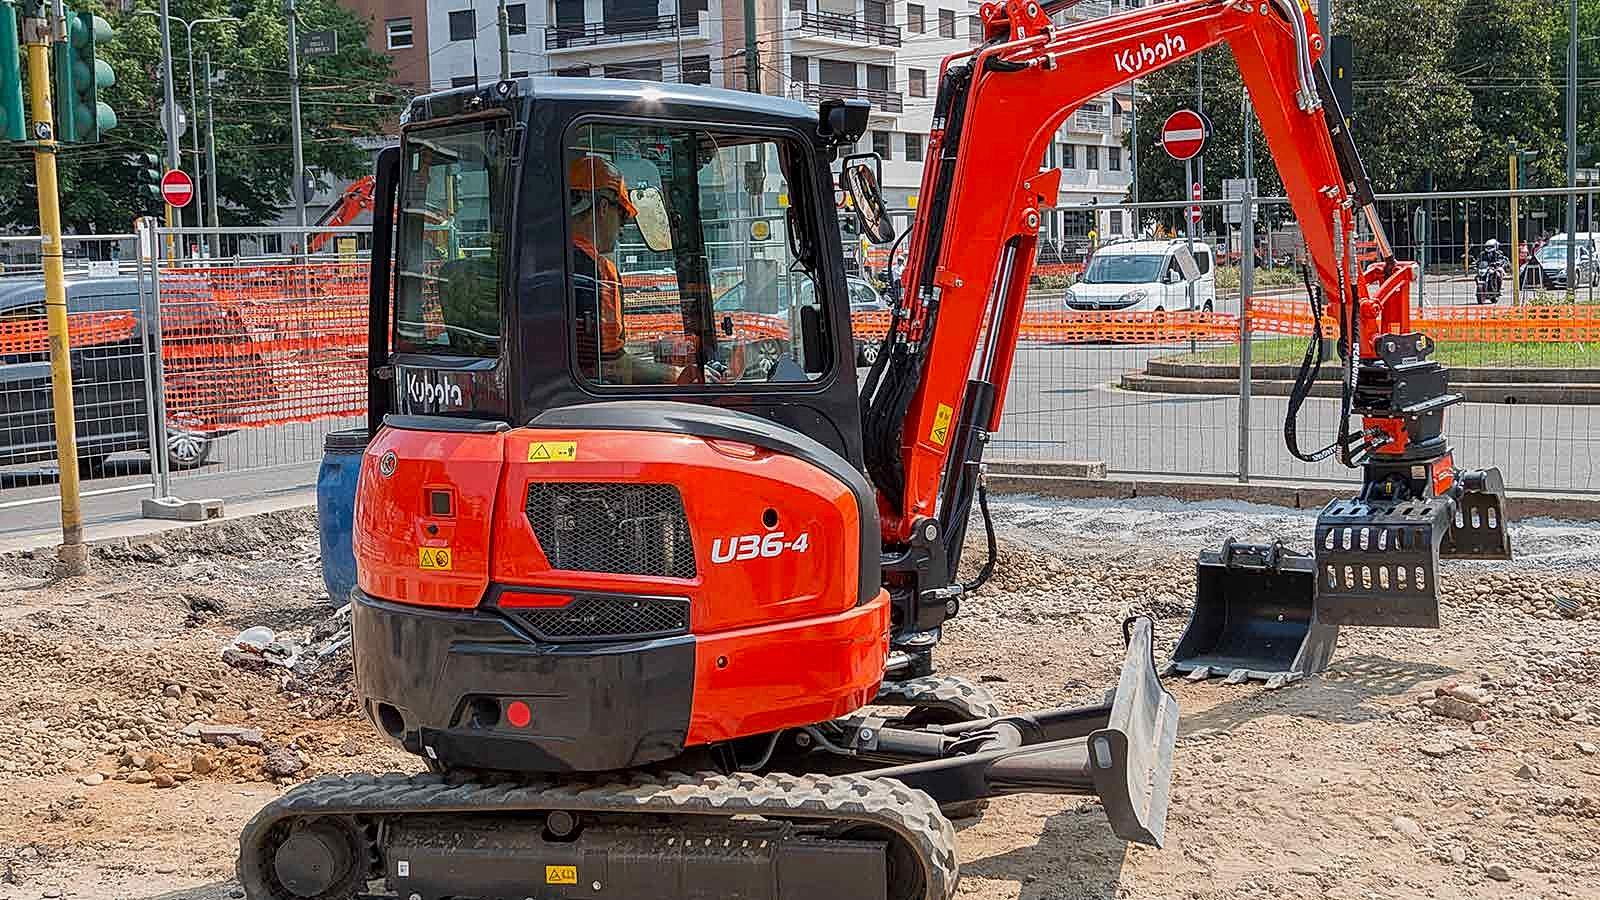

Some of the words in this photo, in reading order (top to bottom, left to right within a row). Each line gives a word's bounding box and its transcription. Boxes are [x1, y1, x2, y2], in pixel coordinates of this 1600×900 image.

[1114, 33, 1186, 73] Kubota
[407, 373, 462, 406] Kubota
[711, 531, 808, 563] U36-4
